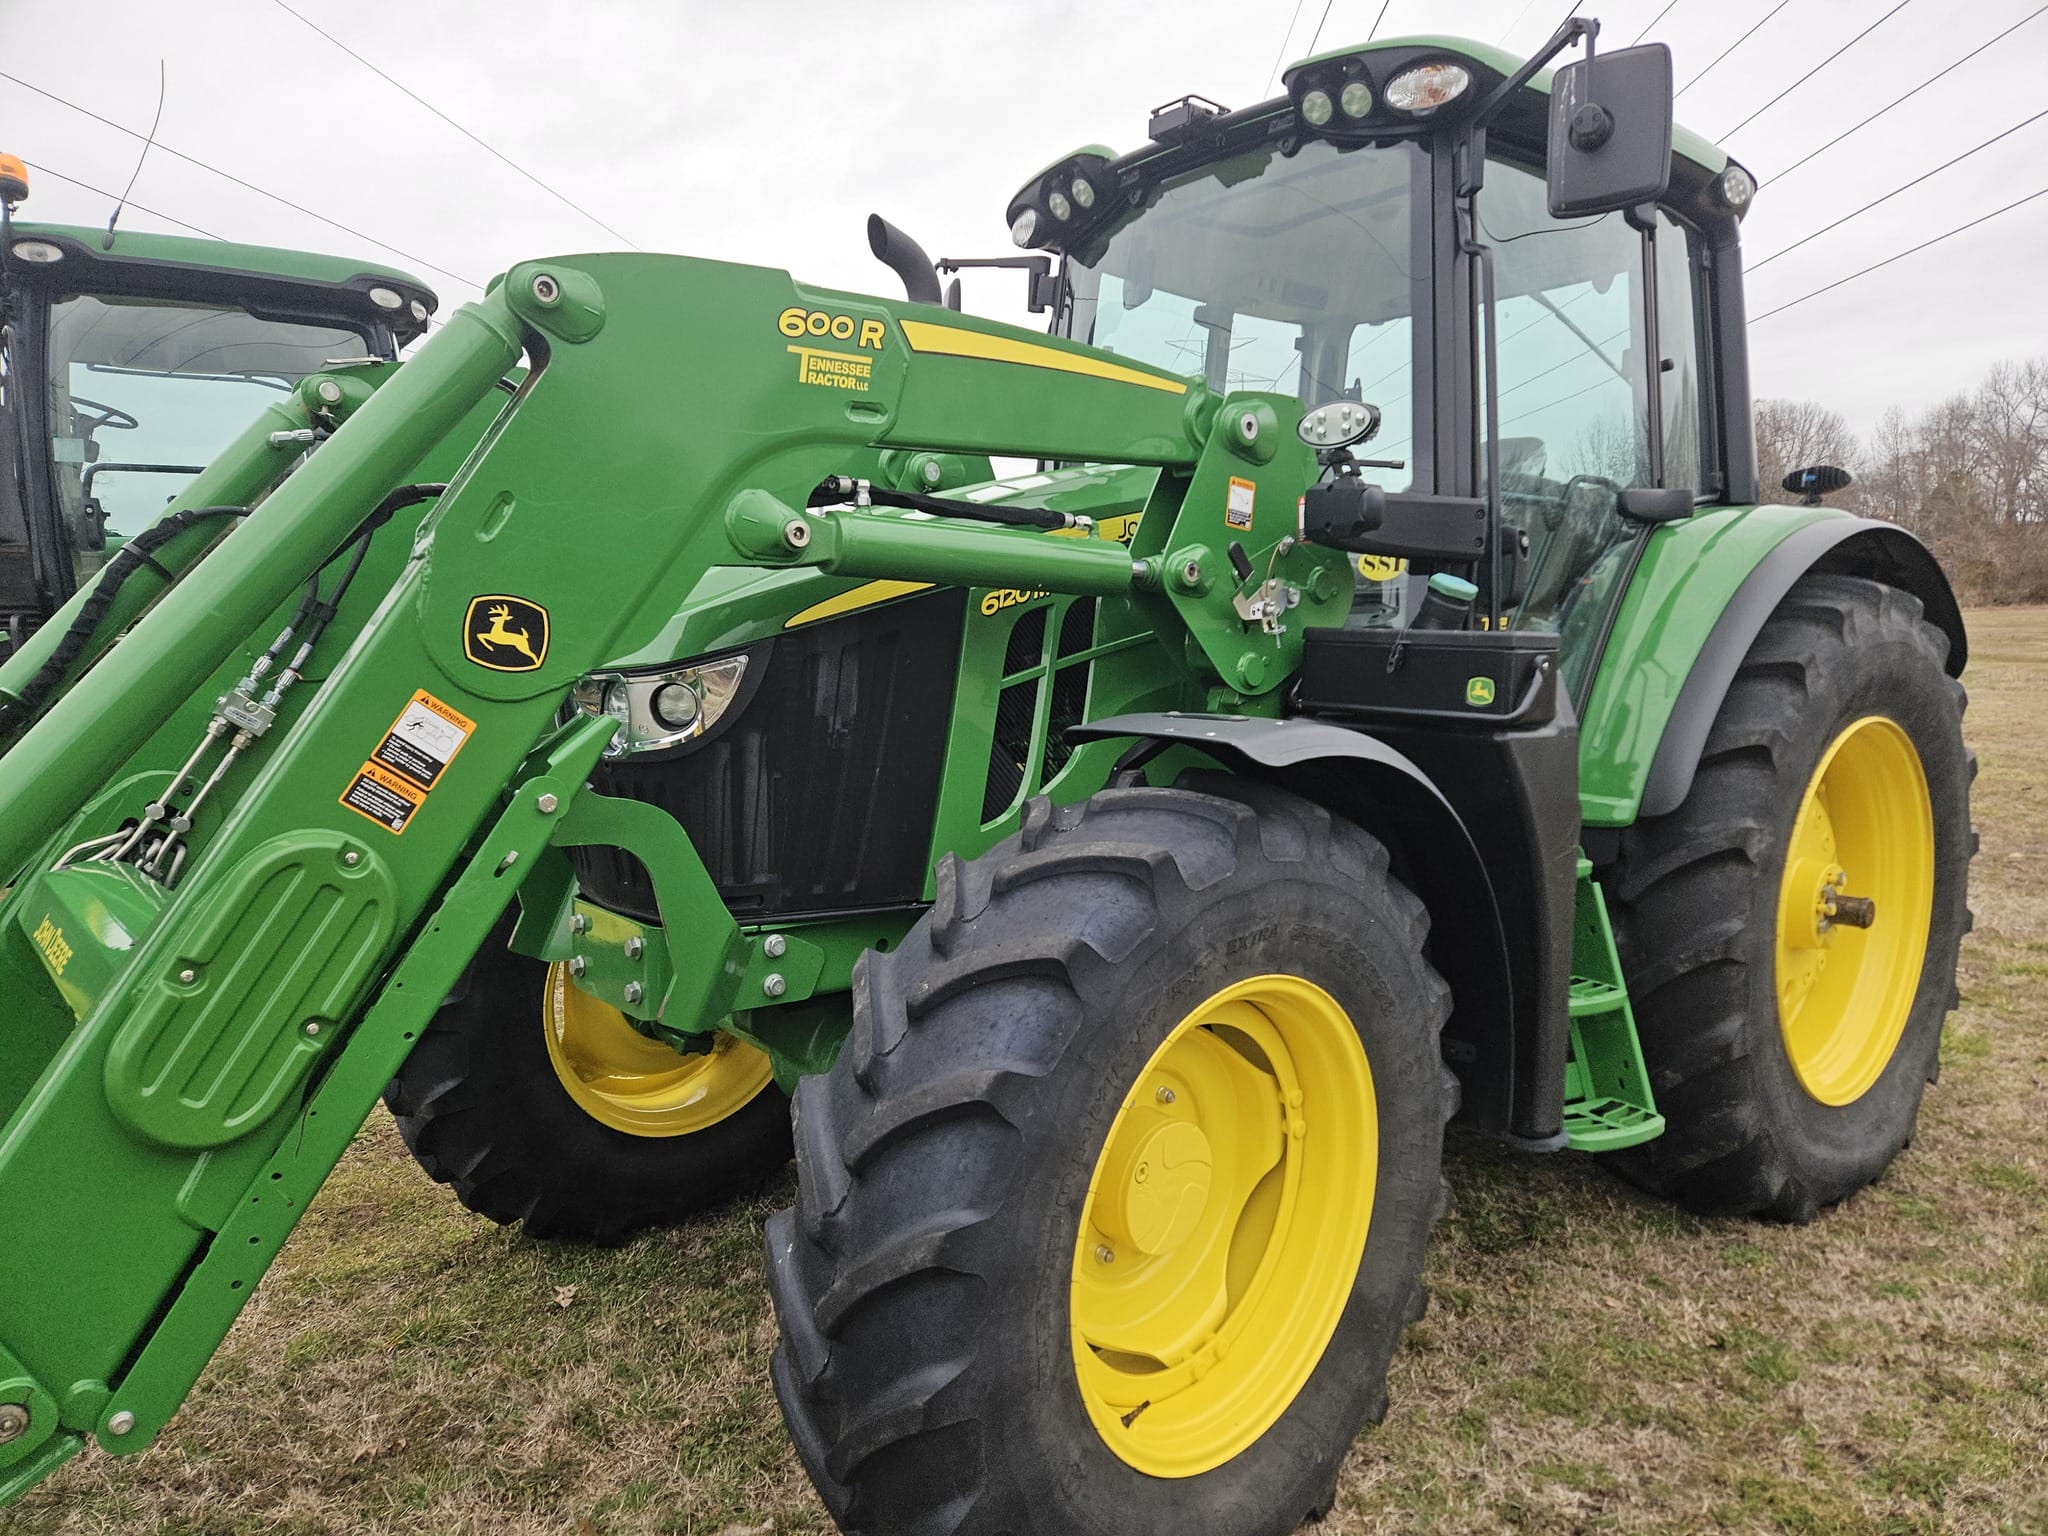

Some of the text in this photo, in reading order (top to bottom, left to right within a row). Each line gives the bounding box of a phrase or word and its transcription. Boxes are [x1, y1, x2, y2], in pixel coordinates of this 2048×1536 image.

[787, 345, 873, 379] TENNESSEE
[1117, 519, 1138, 540] JO
[430, 700, 468, 729] WARNING
[378, 773, 418, 801] WARNING
